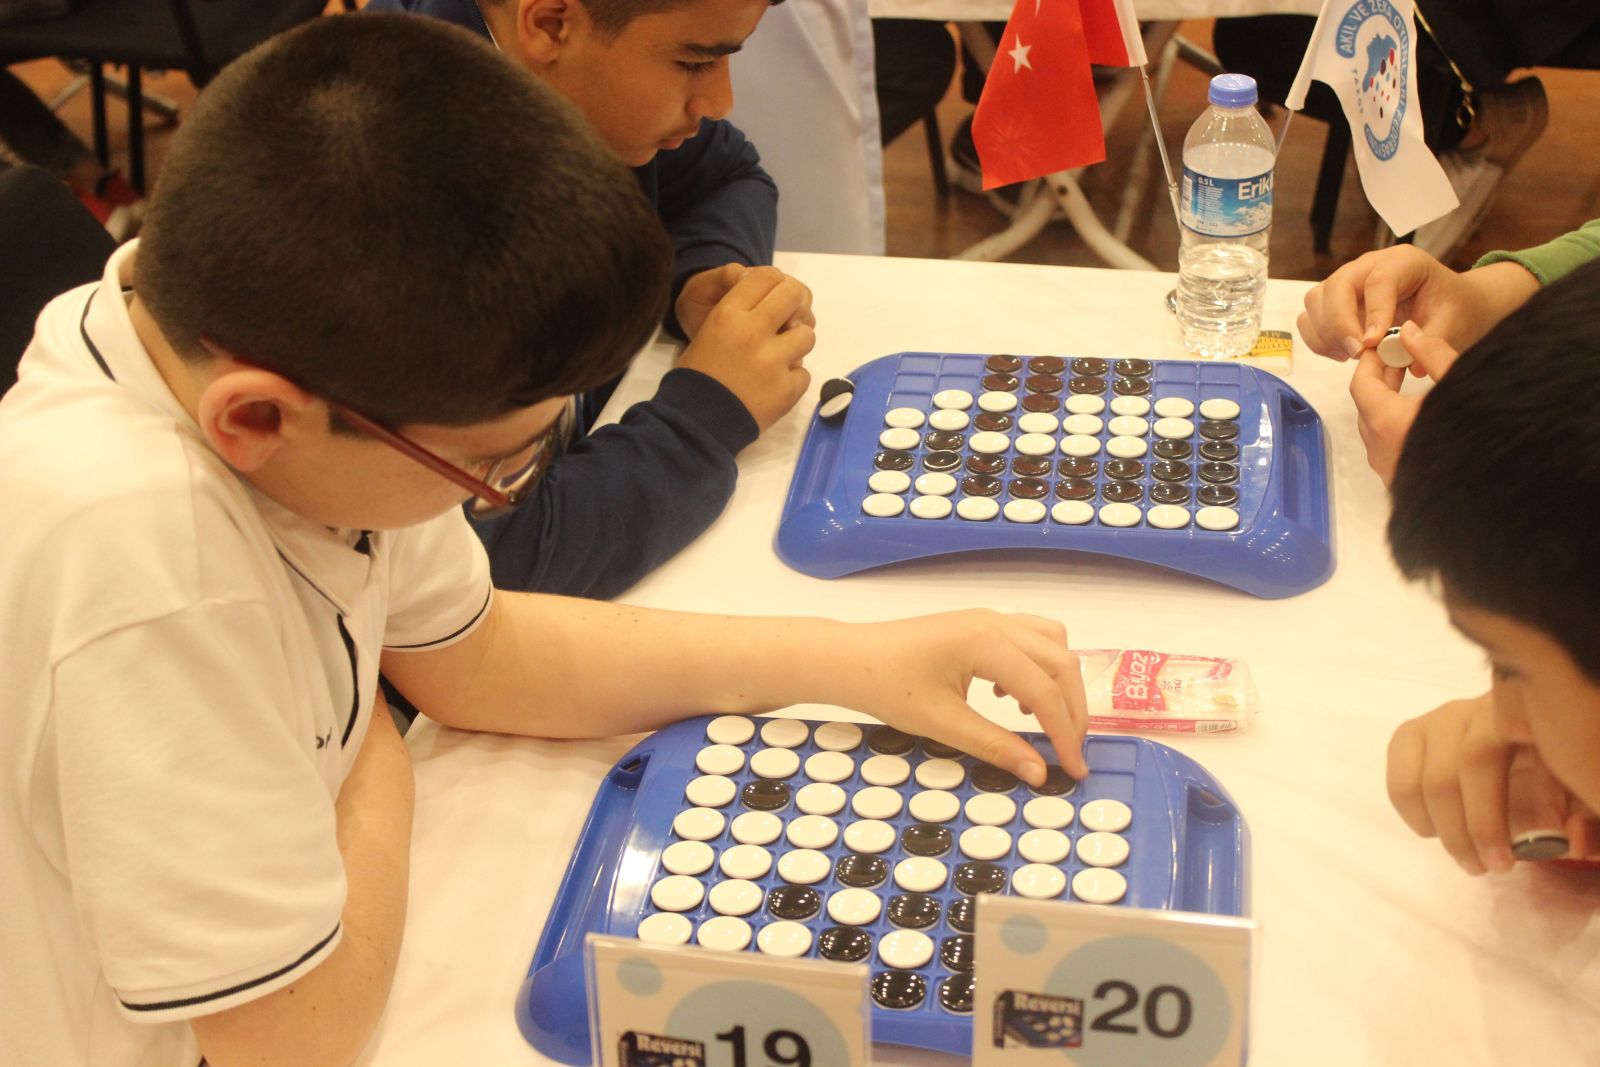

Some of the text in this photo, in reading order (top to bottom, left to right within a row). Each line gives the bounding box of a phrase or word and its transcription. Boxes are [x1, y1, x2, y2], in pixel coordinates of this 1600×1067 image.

[1339, 24, 1358, 54] AKIL
[1349, 3, 1370, 21] VE
[1090, 978, 1193, 1039] 20
[715, 1025, 812, 1067] 19
